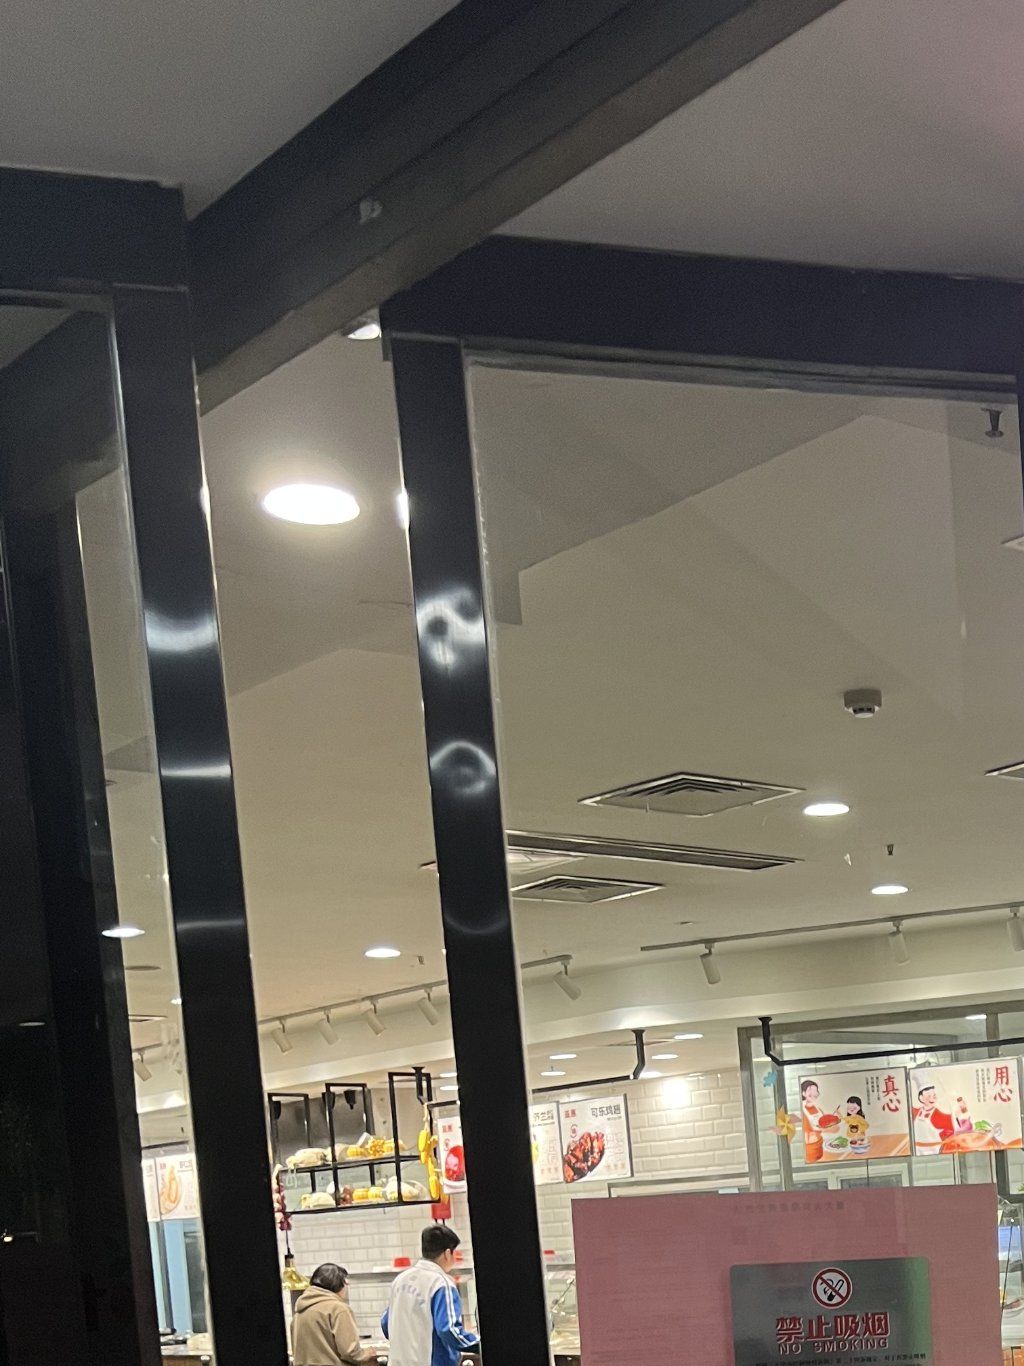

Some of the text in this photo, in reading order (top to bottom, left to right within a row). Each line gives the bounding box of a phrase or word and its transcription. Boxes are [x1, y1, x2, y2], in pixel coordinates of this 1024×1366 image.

[882, 1074, 901, 1113] 真心
[993, 1066, 1013, 1103] 用心
[775, 1312, 891, 1344] 禁止吸烟
[779, 1338, 889, 1355] NO SMOKING
